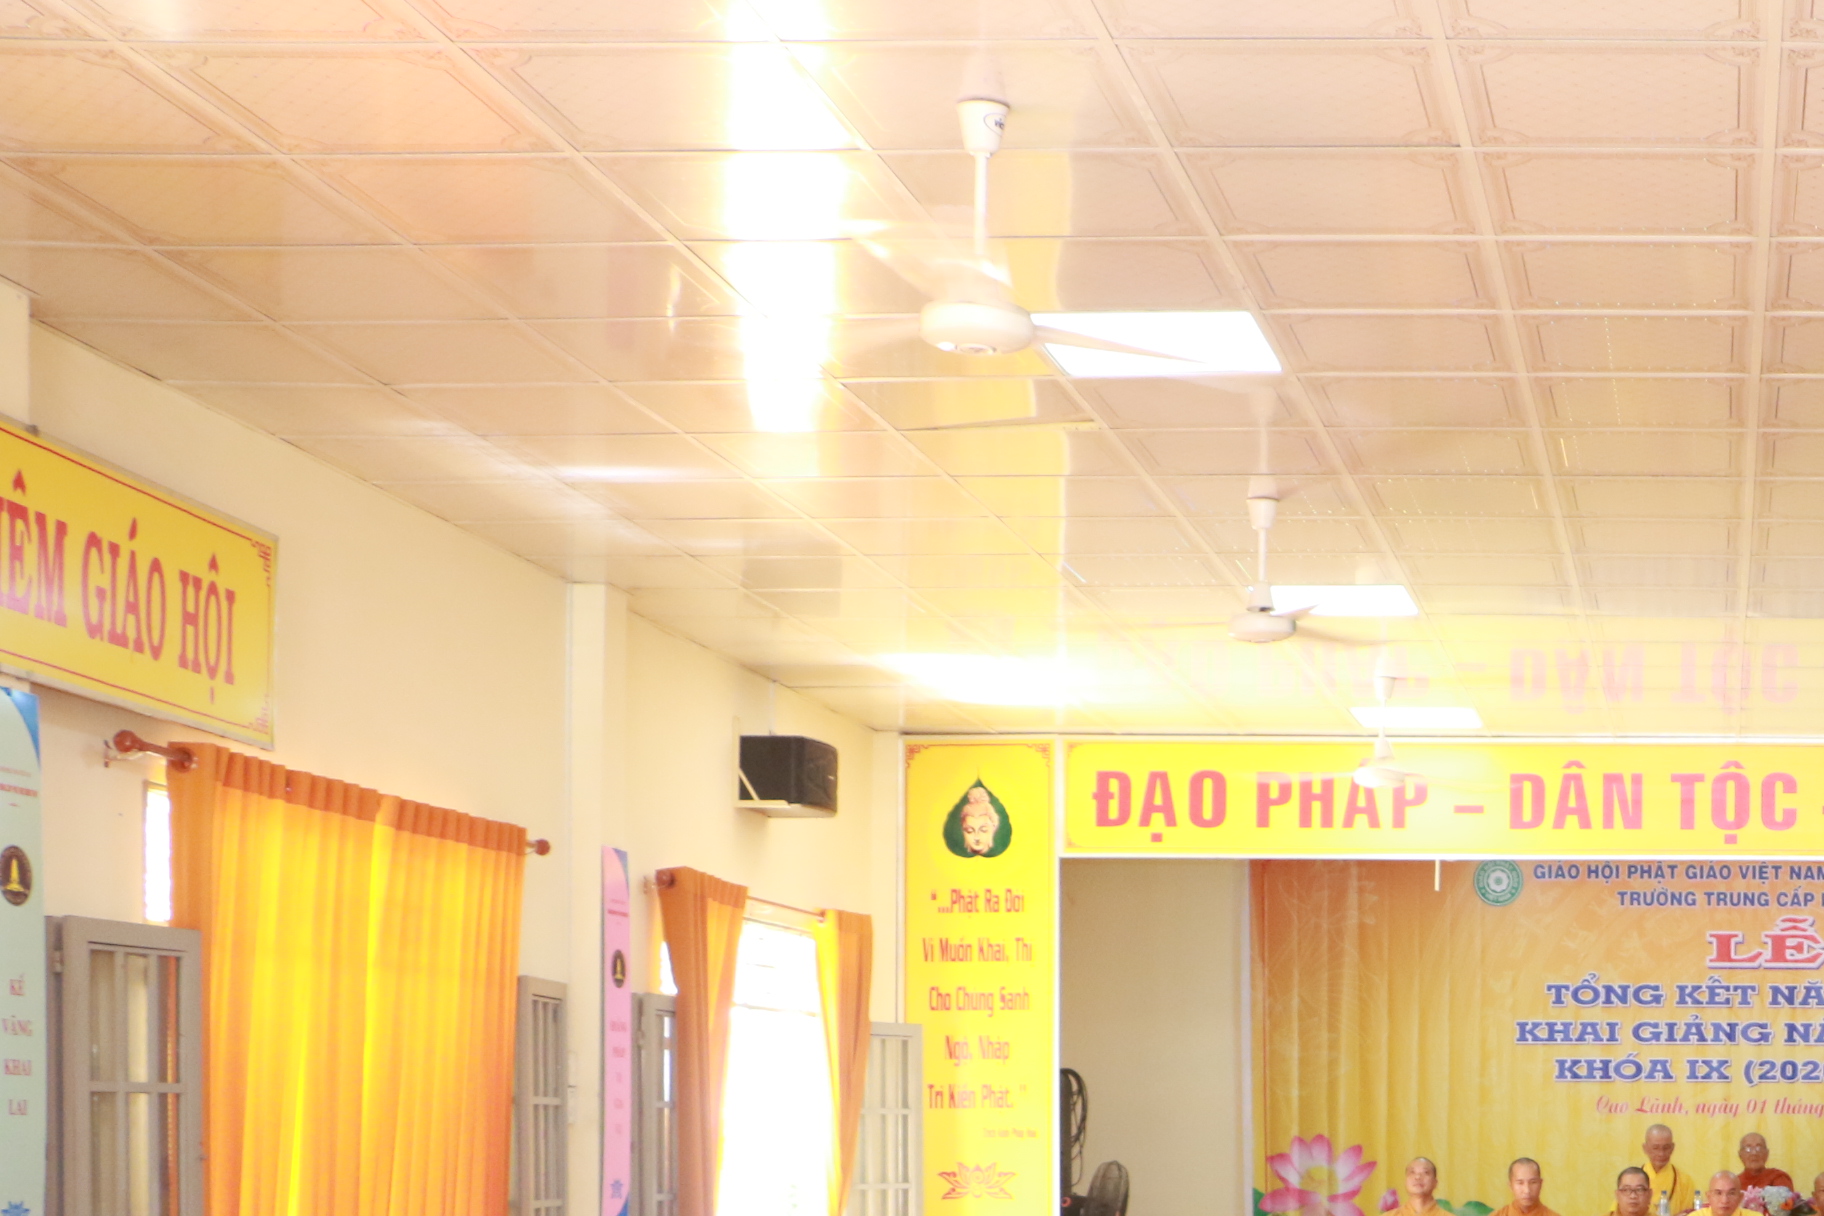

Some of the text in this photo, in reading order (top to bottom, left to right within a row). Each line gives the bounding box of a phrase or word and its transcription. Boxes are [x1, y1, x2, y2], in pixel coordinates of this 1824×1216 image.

[0, 469, 236, 704] ÊM GIÁO HỘI
[1092, 770, 1227, 842] ĐẠO
[1256, 758, 1428, 829] PHÁP
[1509, 760, 1643, 830] DÂN
[1671, 760, 1797, 844] TỘC
[1533, 862, 1581, 880] GIÁO
[1586, 862, 1621, 883] HỘI
[1626, 862, 1681, 884] PHẬT
[1685, 862, 1732, 882] GIÁO
[1738, 862, 1784, 884] VIỆT
[984, 888, 1000, 913] Ra
[1617, 887, 1699, 907] TRƯỜNG
[1704, 892, 1772, 908] TRUNG
[1776, 886, 1815, 908] CẤP
[929, 986, 951, 1011] Cho
[1000, 986, 1030, 1011] Sanh
[1545, 972, 1665, 1008] TỔNG
[1673, 974, 1759, 1008] KẾT
[1514, 1020, 1620, 1045] KHAI
[1630, 1012, 1774, 1045] GIẢNG
[4, 1059, 31, 1076] KHAI
[1553, 1052, 1675, 1083] KHÓA
[1684, 1058, 1732, 1083] IX
[8, 1100, 27, 1116] LAI
[1635, 1095, 1690, 1117] Lãnh,
[1695, 1098, 1742, 1119] ngày
[1745, 1098, 1768, 1115] 01
